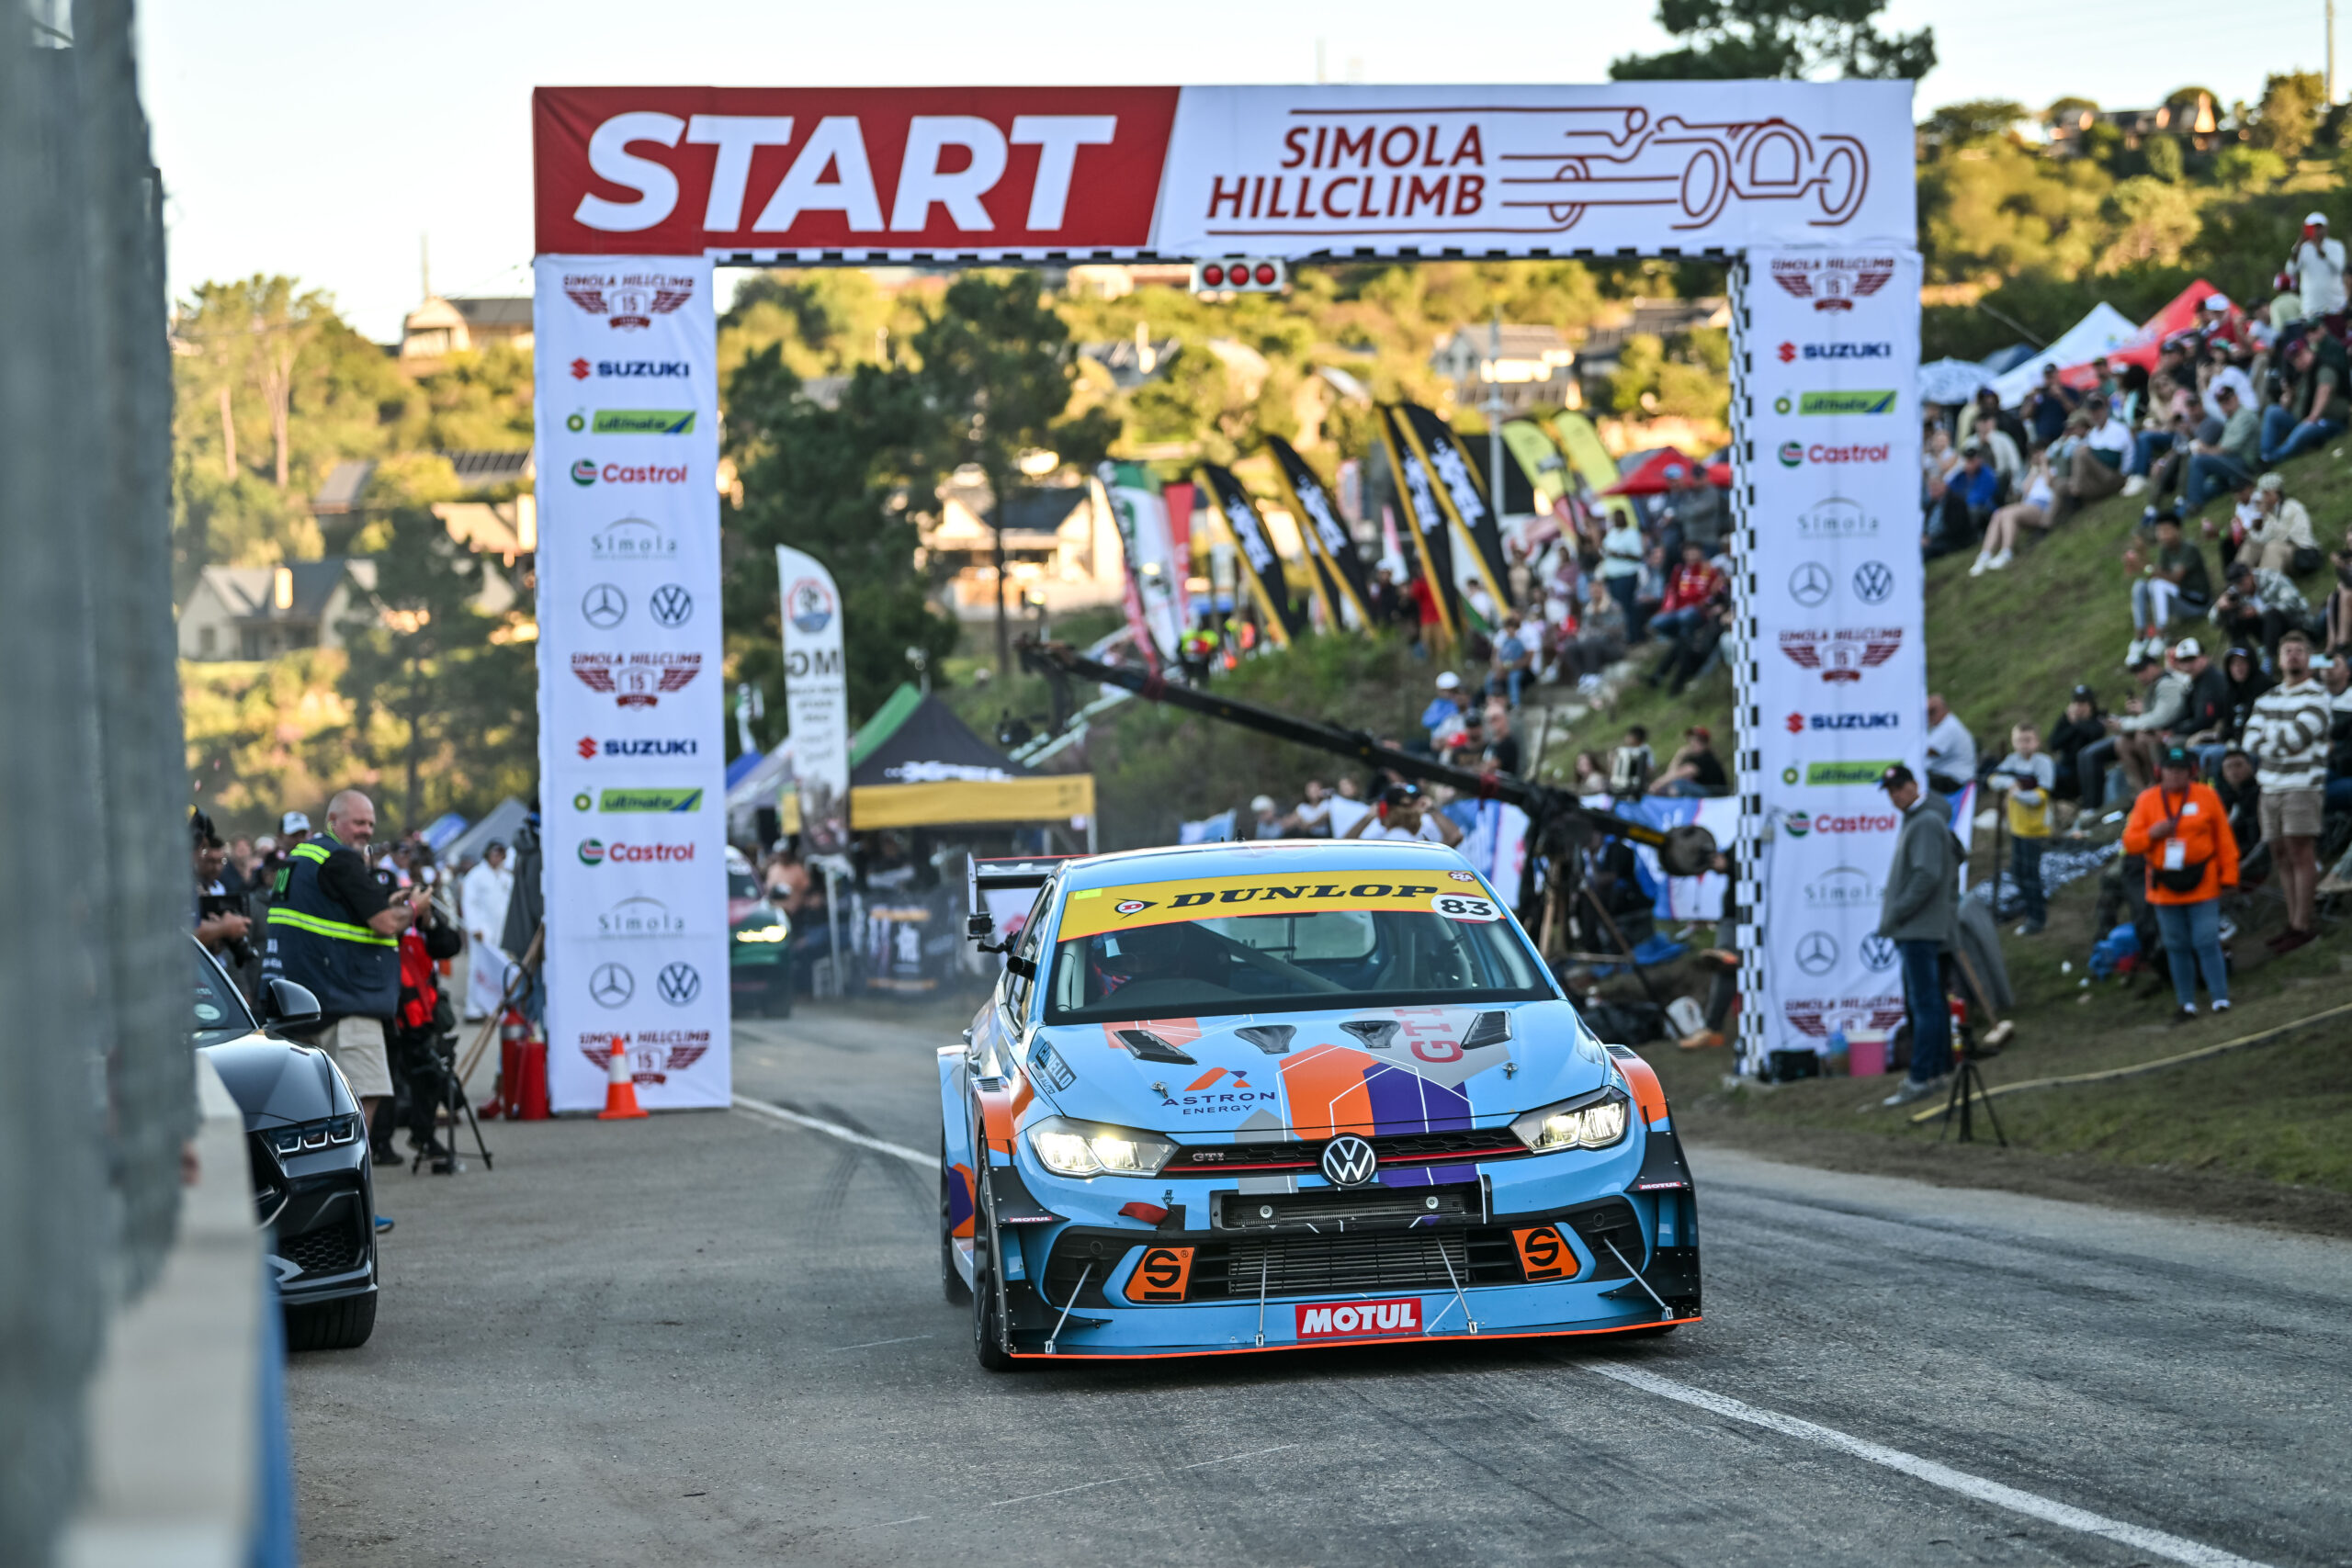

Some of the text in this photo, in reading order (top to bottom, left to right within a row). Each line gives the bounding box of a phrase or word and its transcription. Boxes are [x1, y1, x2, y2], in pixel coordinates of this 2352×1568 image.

[1281, 125, 1485, 169] SIMOLA
[573, 111, 1117, 232] START
[1205, 175, 1485, 219] HILLCLIMB
[1804, 342, 1891, 358] SUZUKI
[597, 361, 690, 378] SUZUKI
[1808, 444, 1889, 462] Castrol
[602, 464, 687, 483] Castrol
[1811, 712, 1898, 729] SUZUKI
[605, 739, 697, 755] SUZUKI
[1815, 814, 1896, 833] Castrol
[609, 842, 695, 862] Castrol
[1167, 885, 1439, 908] DUNLOP
[1440, 899, 1492, 916] 83
[1393, 1009, 1464, 1063] GTI
[1040, 1077, 1056, 1095] AUTO
[1161, 1091, 1275, 1106] ASTRON
[1182, 1104, 1252, 1115] ENERGY
[1192, 1152, 1225, 1161] GTI
[1301, 1303, 1417, 1334] MOTUL
